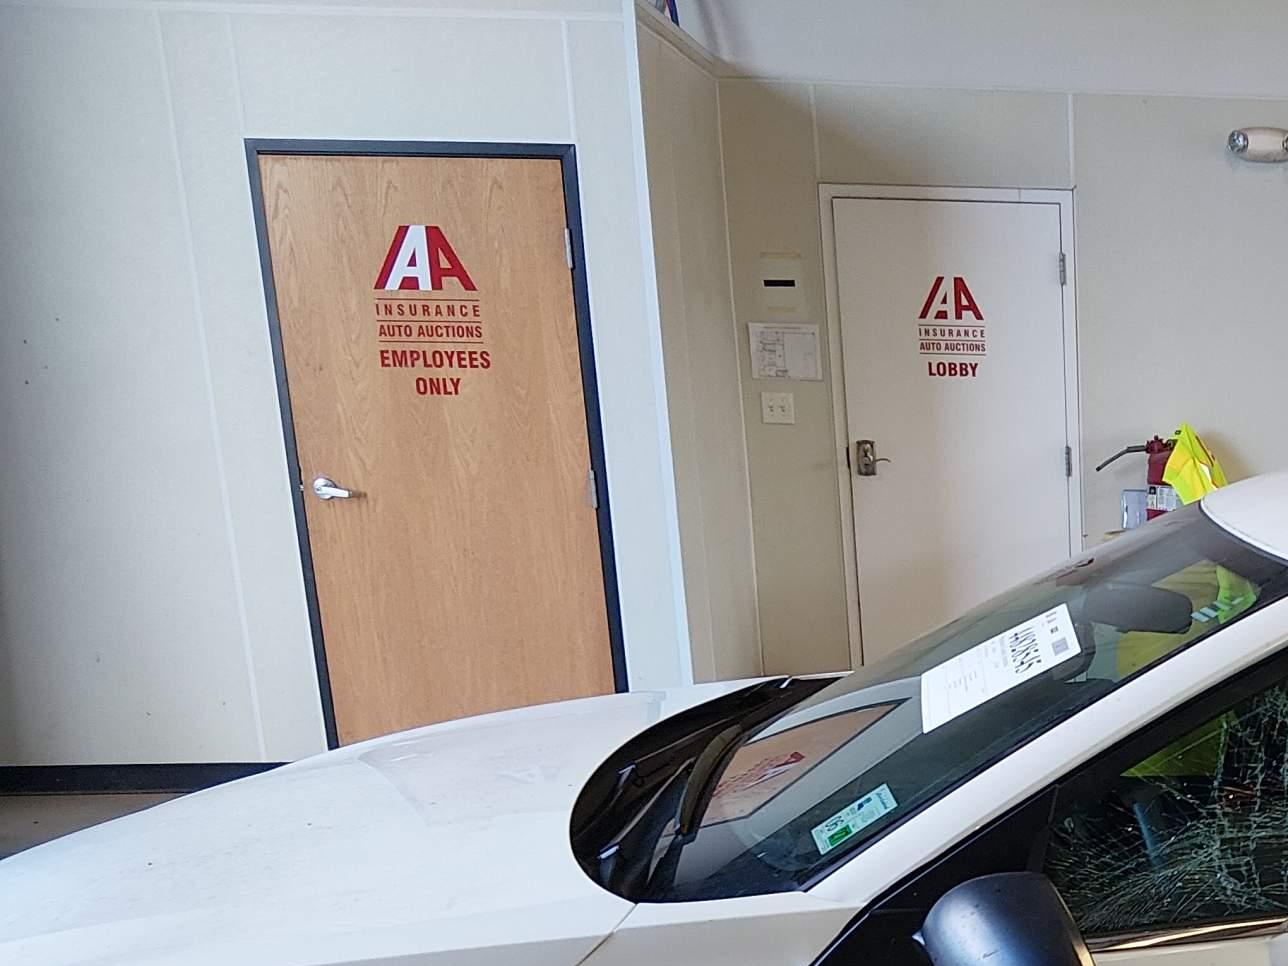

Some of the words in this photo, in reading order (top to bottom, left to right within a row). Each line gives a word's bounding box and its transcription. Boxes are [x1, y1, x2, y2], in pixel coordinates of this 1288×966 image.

[375, 303, 481, 317] INSURANCE
[378, 324, 413, 337] AUTO
[417, 325, 483, 338] AUCTIONS
[918, 327, 985, 338] INSURANCE
[919, 341, 942, 351] AUTO
[944, 342, 986, 352] AUCTIONS
[379, 349, 491, 369] EMPLOYEES
[928, 361, 979, 377] LOBBY
[415, 377, 462, 396] ONLY
